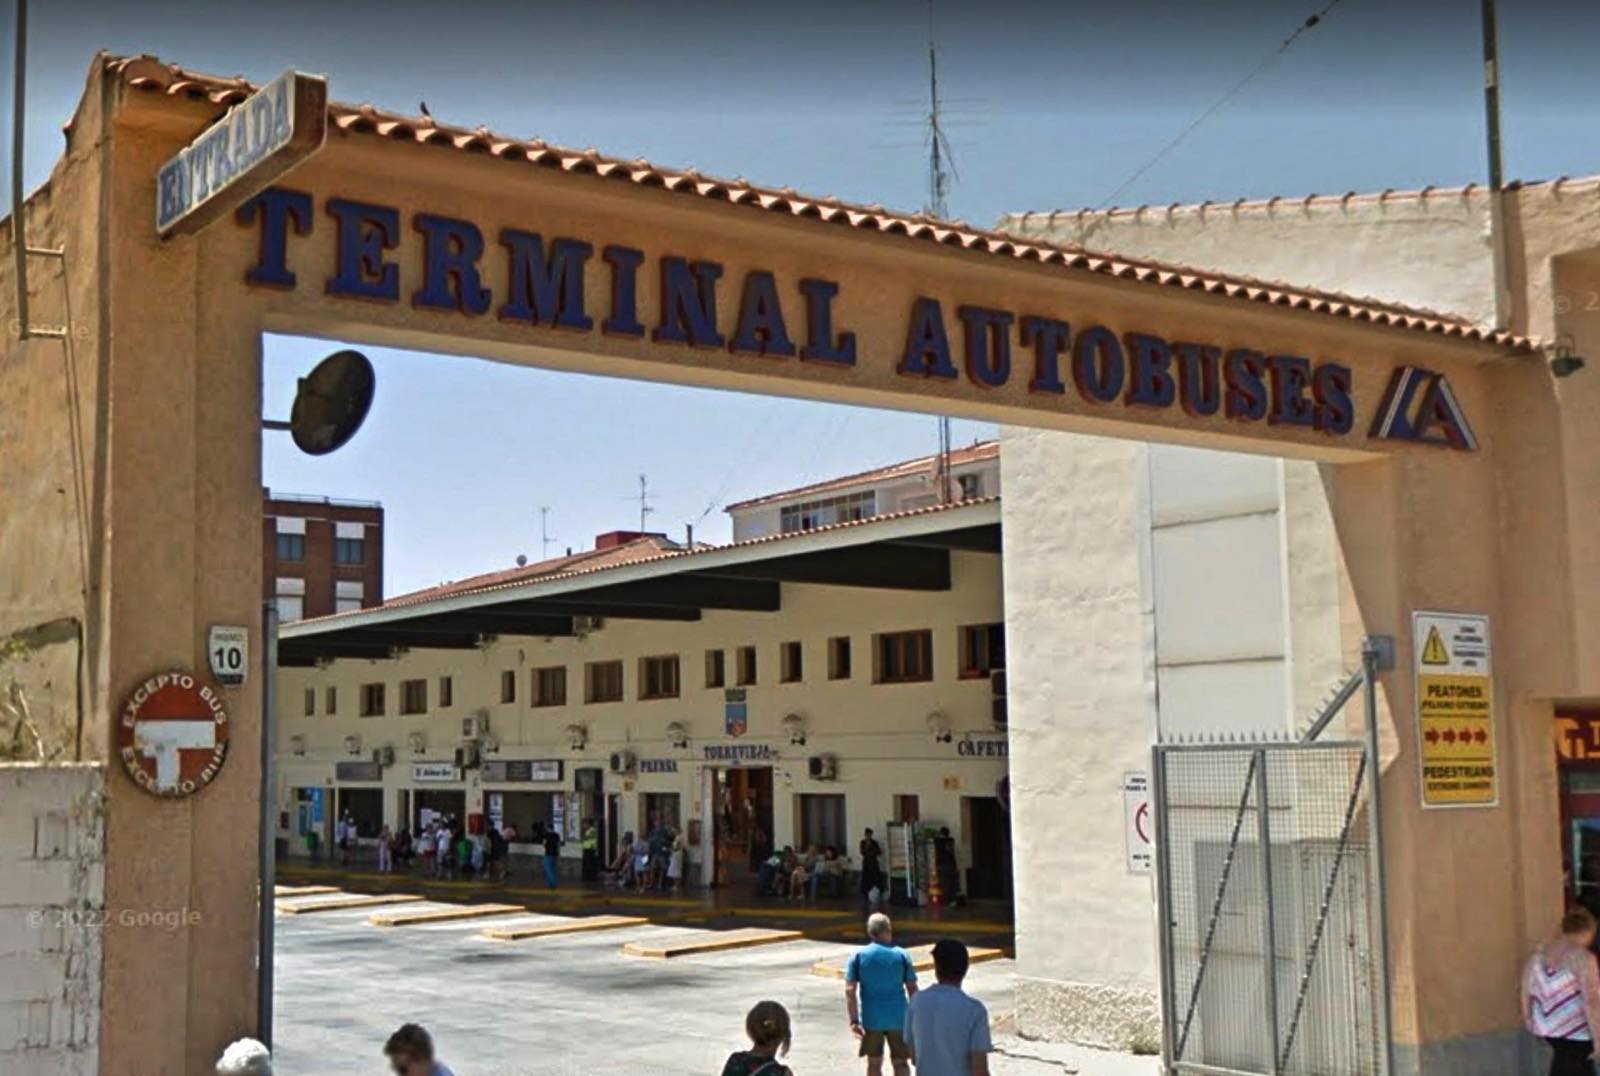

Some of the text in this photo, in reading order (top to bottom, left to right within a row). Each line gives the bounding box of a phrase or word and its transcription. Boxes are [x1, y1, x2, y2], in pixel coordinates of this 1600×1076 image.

[236, 189, 1356, 436] TERMINAL AUTOBUSES
[214, 647, 242, 670] 10
[122, 672, 227, 728] EXCEPTO BUS
